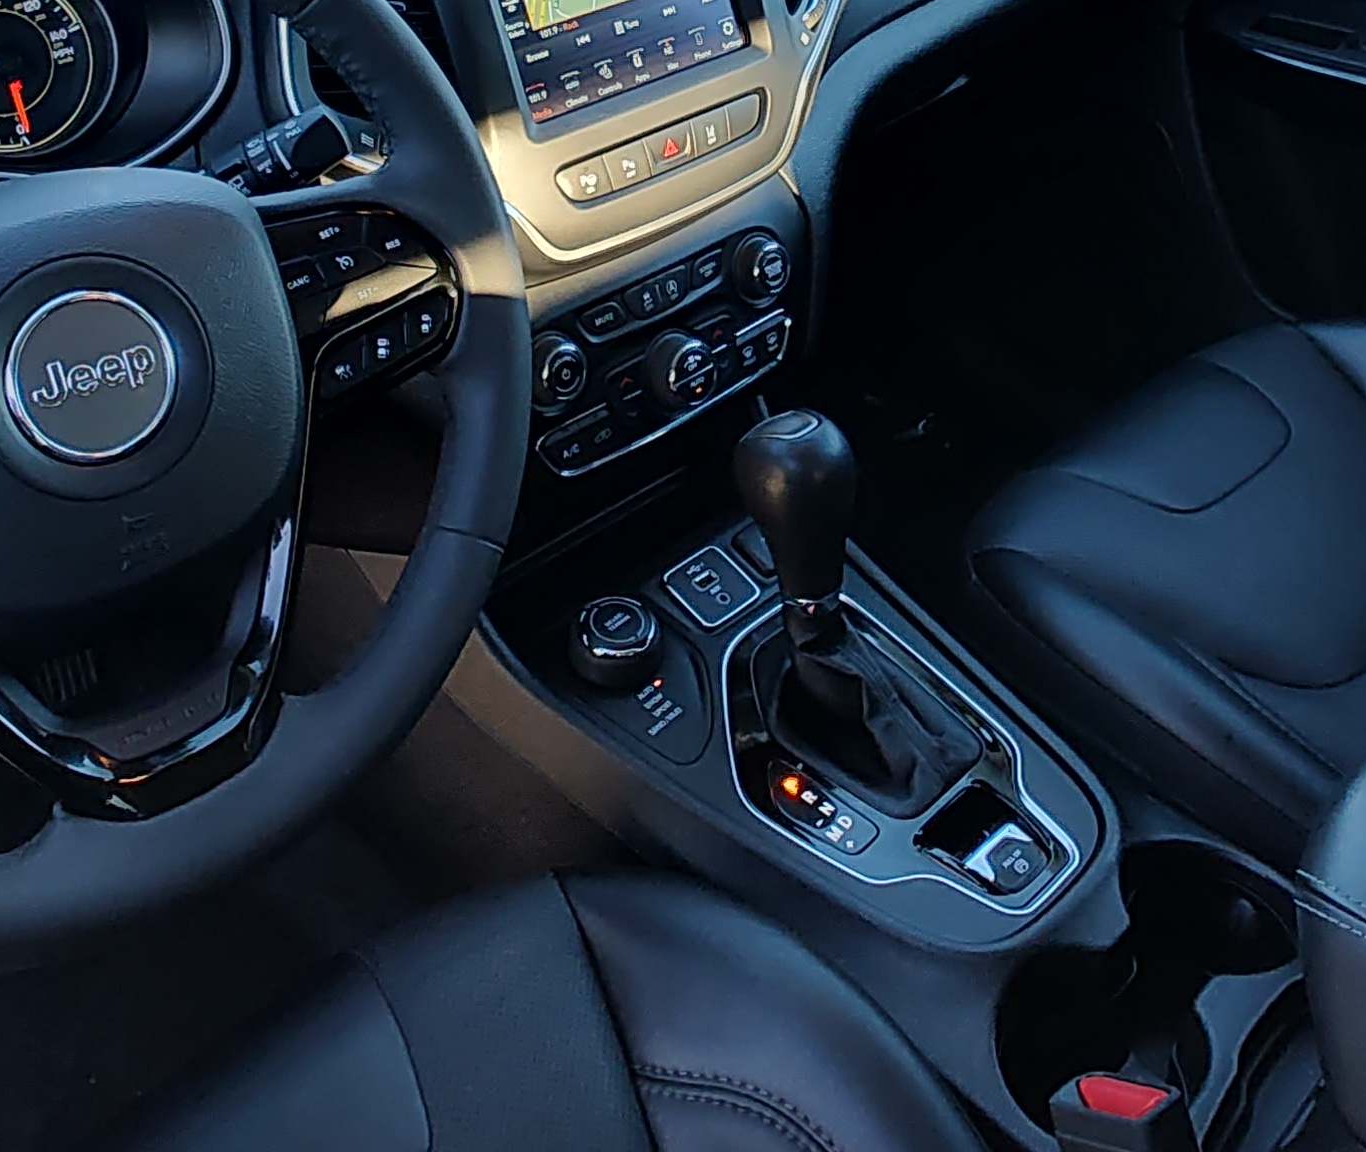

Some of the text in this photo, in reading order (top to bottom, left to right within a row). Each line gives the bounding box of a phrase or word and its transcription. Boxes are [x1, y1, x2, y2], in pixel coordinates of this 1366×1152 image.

[539, 25, 559, 39] 101.9
[597, 81, 623, 96] Controls
[286, 274, 311, 291] CANC
[594, 311, 615, 327] MUTE
[30, 344, 156, 408] Jeep
[563, 443, 581, 459] A/C
[800, 790, 819, 806] R
[818, 801, 836, 818] N
[837, 815, 853, 830] D
[825, 825, 845, 843] M
